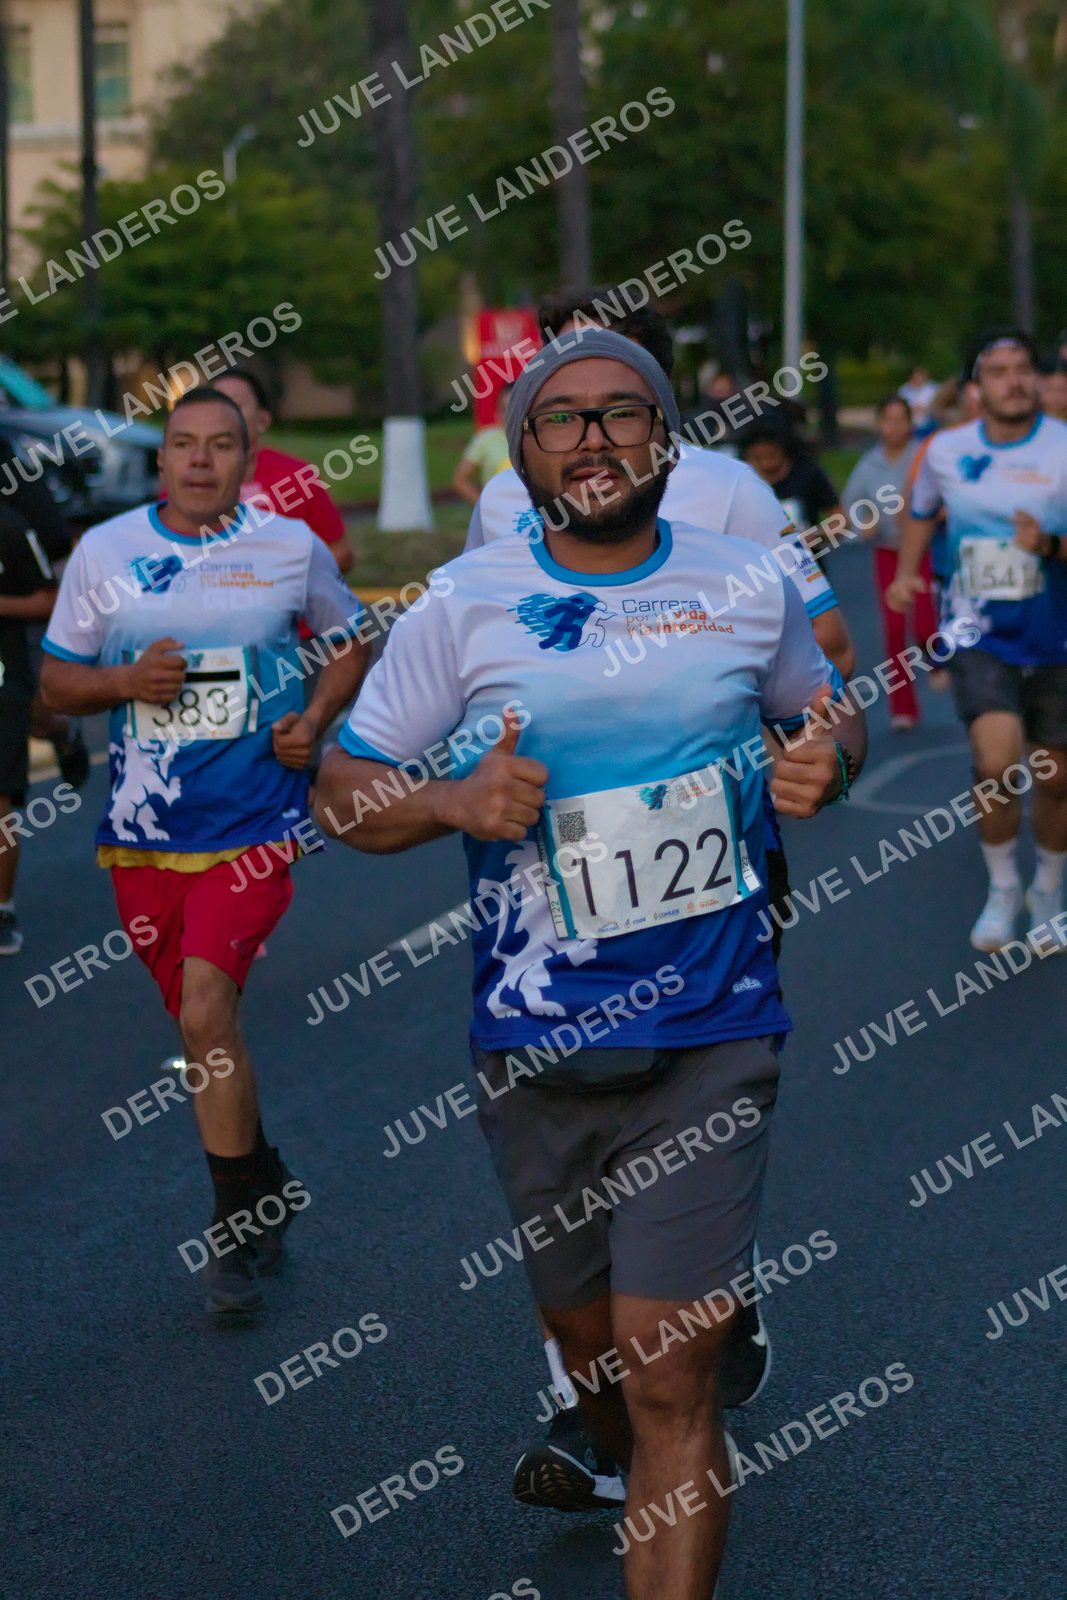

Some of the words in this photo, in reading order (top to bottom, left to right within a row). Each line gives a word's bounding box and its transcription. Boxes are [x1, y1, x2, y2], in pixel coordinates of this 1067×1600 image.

[622, 599, 701, 613] Carrera
[626, 615, 649, 626] por
[570, 827, 732, 917] 1122
[551, 900, 563, 925] 1122
